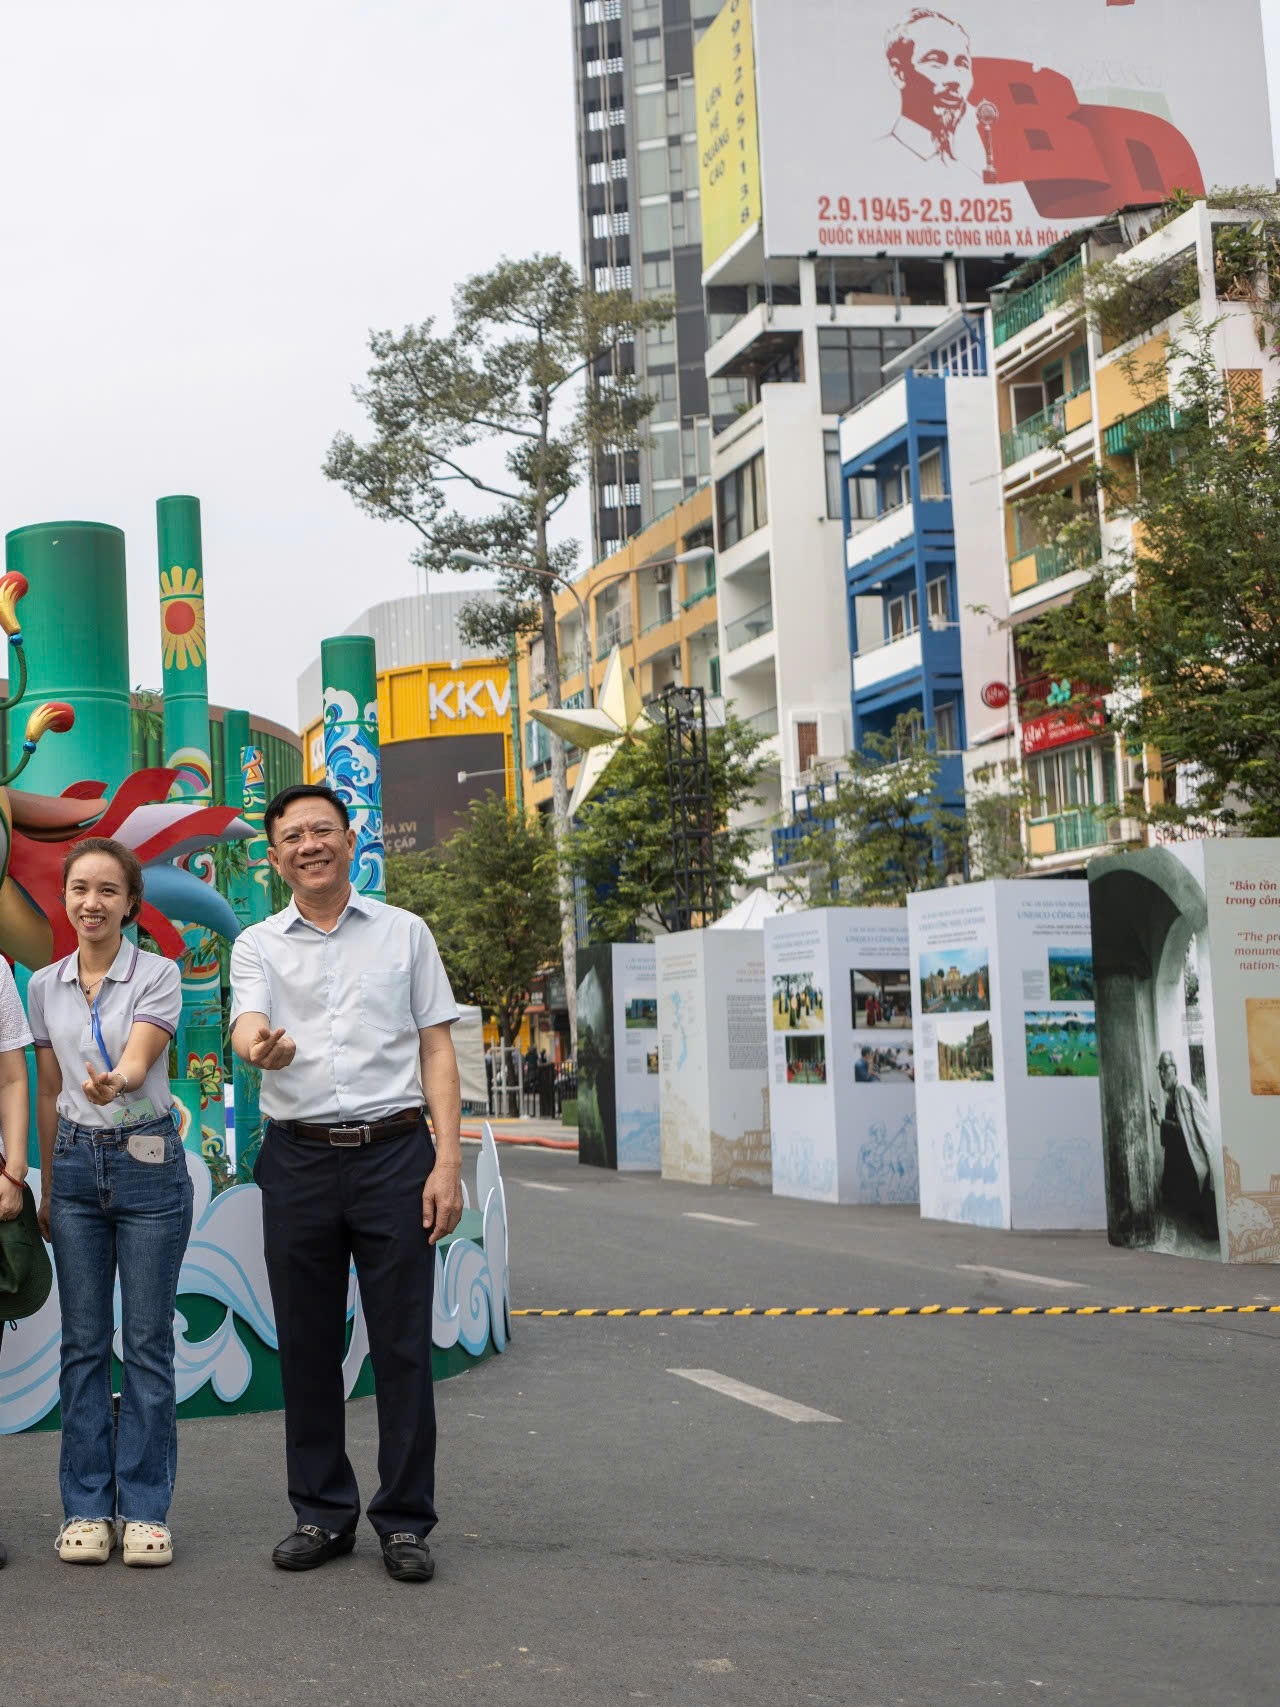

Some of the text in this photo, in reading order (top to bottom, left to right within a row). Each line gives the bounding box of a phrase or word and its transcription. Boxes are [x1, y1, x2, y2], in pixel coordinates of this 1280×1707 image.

[818, 195, 1012, 222] 2.9.1945-2.9.2025
[819, 225, 853, 246] QUỐC
[858, 226, 902, 245] KHÁNH
[906, 226, 940, 246] NƯỚC
[946, 227, 981, 249] CỘNG
[986, 226, 1011, 246] HÒA
[1015, 226, 1033, 246] XÃ
[428, 679, 511, 720] KKV
[399, 821, 417, 833] XVI
[1225, 895, 1256, 907] trong
